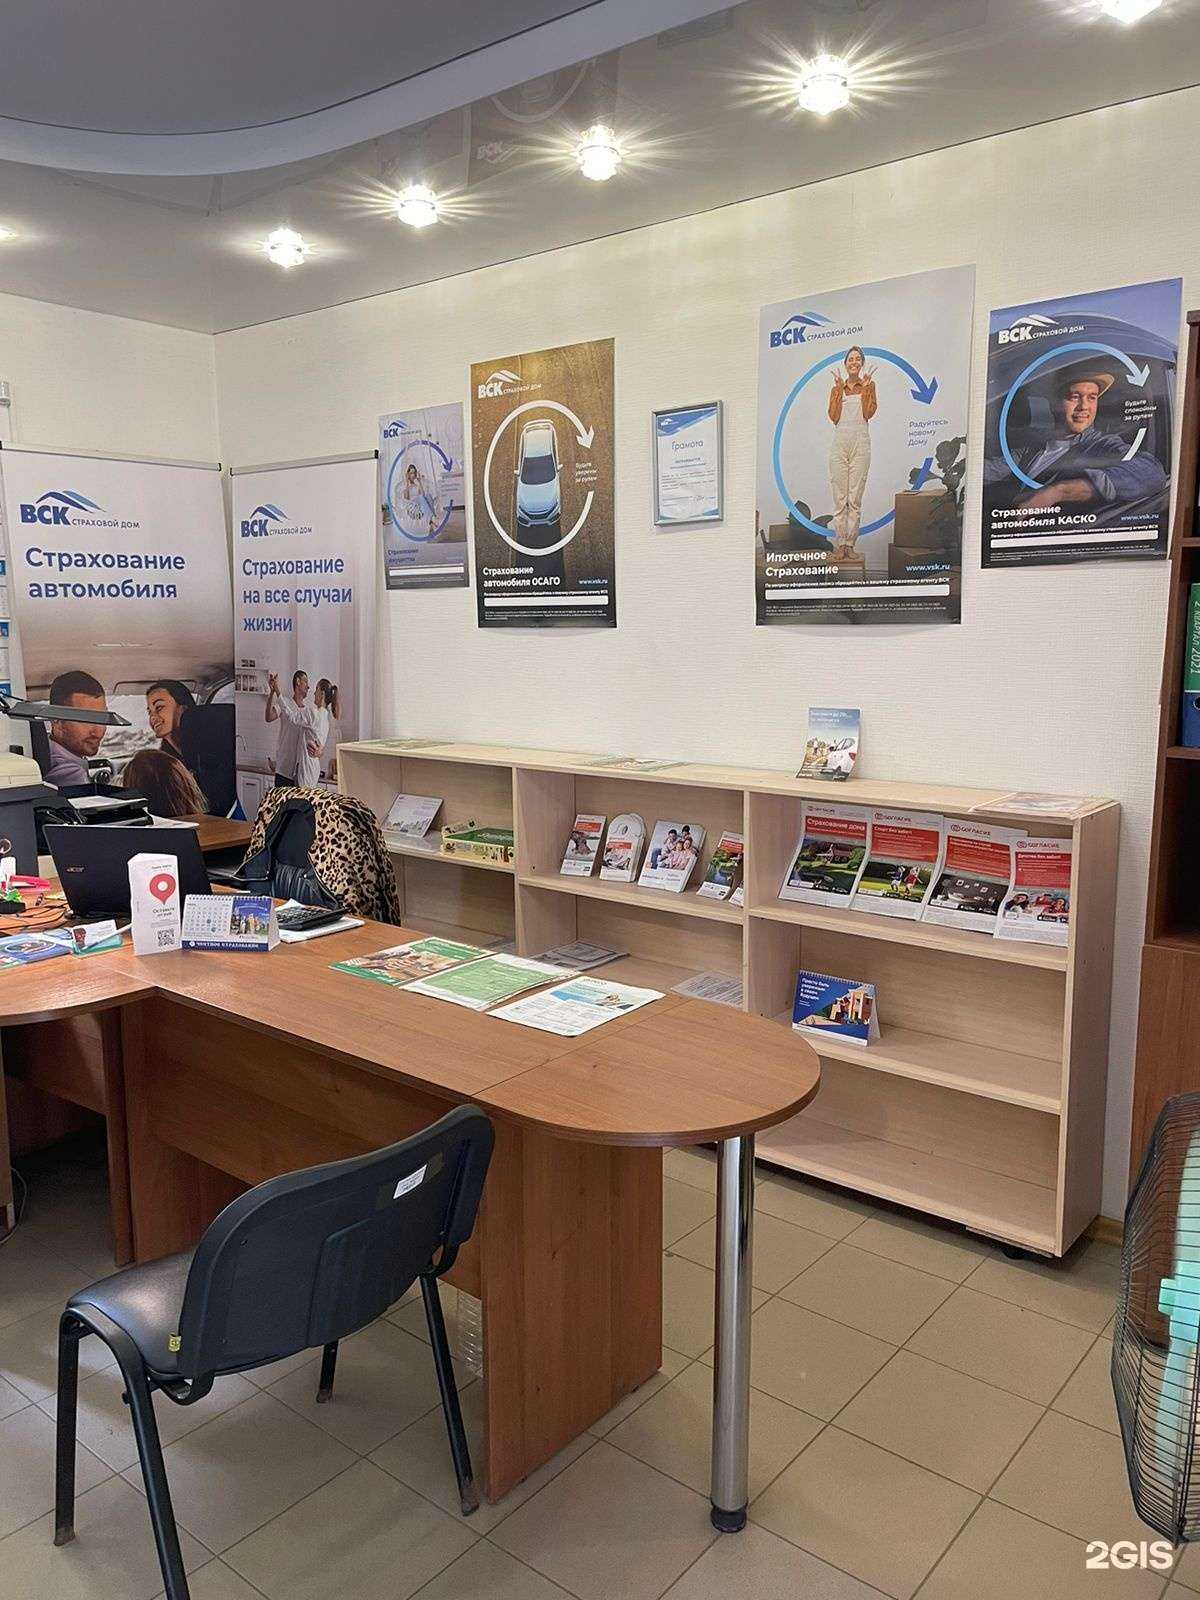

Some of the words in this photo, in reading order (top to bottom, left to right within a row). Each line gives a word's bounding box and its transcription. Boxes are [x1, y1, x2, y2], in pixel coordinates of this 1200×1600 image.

[770, 326, 806, 348] ВСК
[807, 329, 847, 341] СТРАХОВОЙ
[848, 326, 863, 335] ДОМ
[998, 326, 1033, 344] ВСК
[478, 381, 503, 399] ВСК
[909, 420, 949, 428] Радуйтесь
[383, 428, 399, 439] ВСК
[672, 440, 704, 451] Грамота
[20, 504, 70, 525] ВСК
[72, 518, 119, 528] СТРАХОВОЙ
[121, 521, 140, 529] ДОМ
[991, 506, 1061, 518] Страхование
[1121, 513, 1159, 521] www.vsk.ru
[240, 519, 269, 537] ВСК
[269, 527, 299, 536] СТРАХОВОЙ
[991, 518, 1056, 529] автомобиля
[1058, 514, 1097, 525] КАСКО
[26, 547, 185, 571] Страхование
[767, 552, 827, 563] Ипотечное
[243, 559, 344, 579] Страхование
[483, 566, 534, 577] Страхование
[765, 565, 839, 578] Страхование
[905, 563, 950, 572] www.vsk.ru
[29, 579, 177, 598] автомобиля
[484, 578, 531, 587] автомобиля
[532, 577, 560, 586] ОСАГО
[243, 590, 260, 603] на
[265, 589, 290, 603] все
[294, 588, 352, 607] случаи
[243, 618, 292, 632] жизни
[807, 818, 848, 829] Страхование
